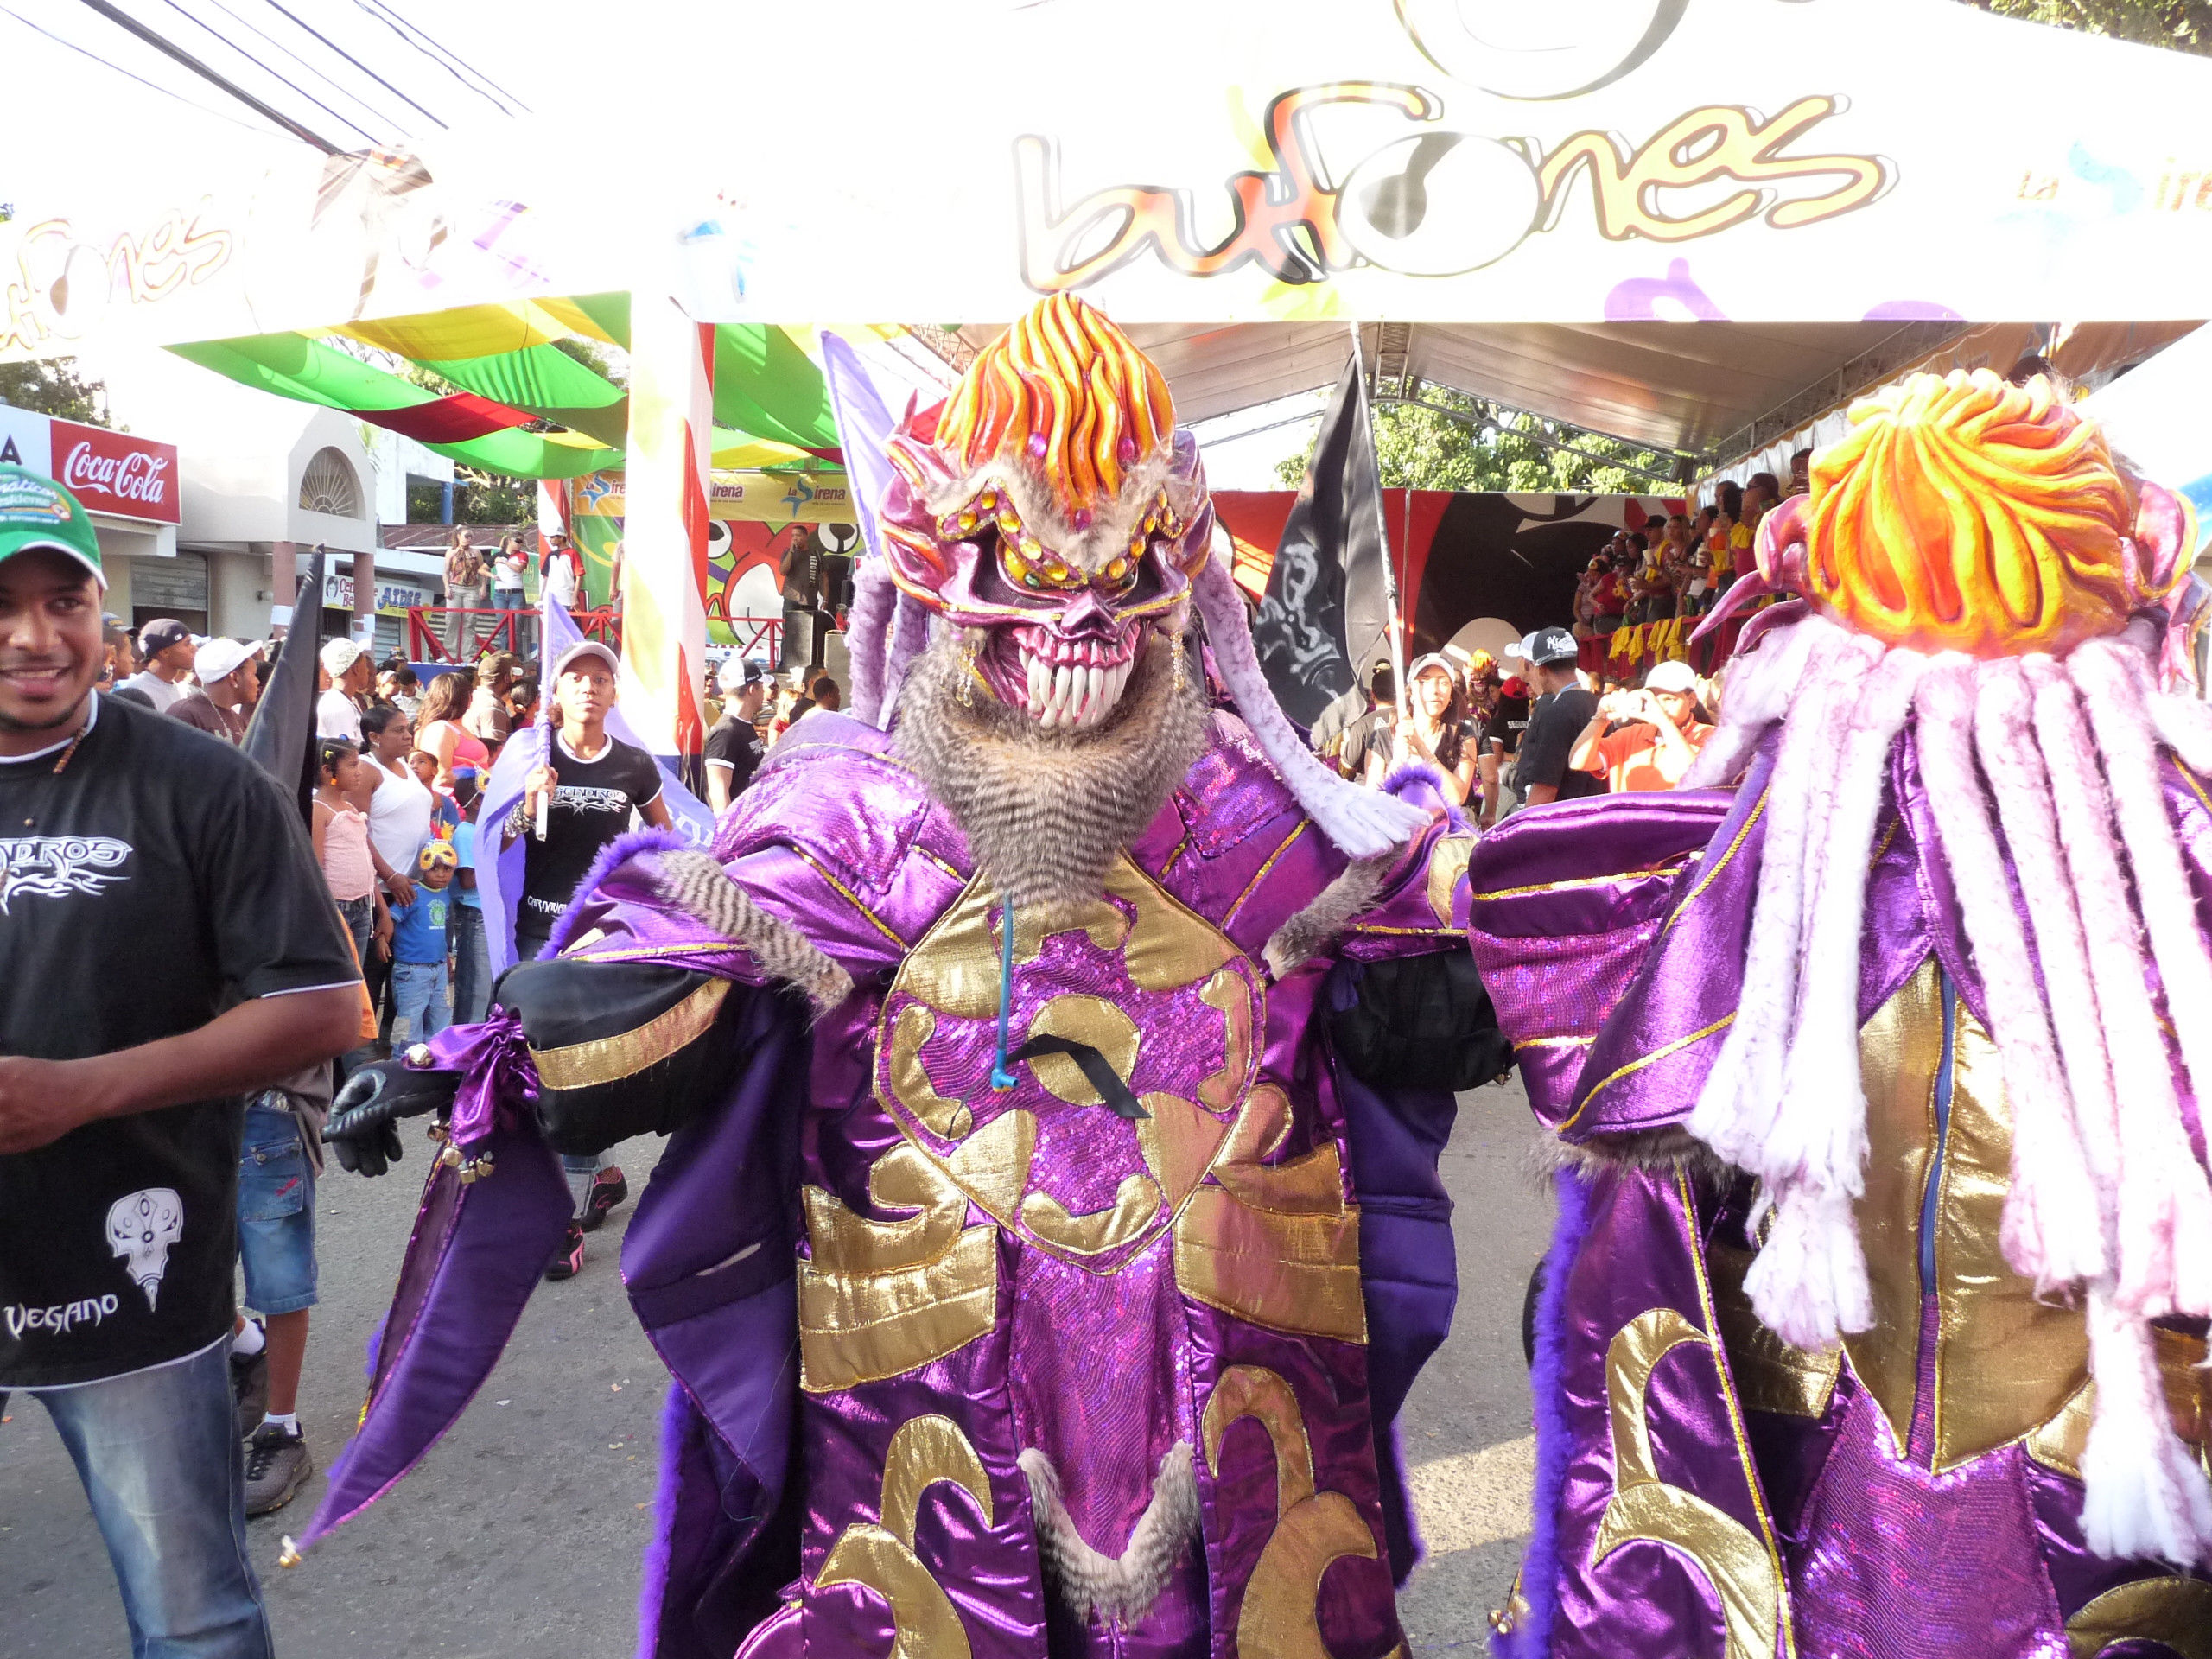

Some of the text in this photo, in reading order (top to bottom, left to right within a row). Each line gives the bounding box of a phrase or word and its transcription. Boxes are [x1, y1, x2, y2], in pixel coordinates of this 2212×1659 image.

[64, 442, 168, 504] Coca-Cola
[711, 482, 743, 498] irena
[788, 487, 798, 496] La
[3, 1294, 119, 1341] VEGANO
